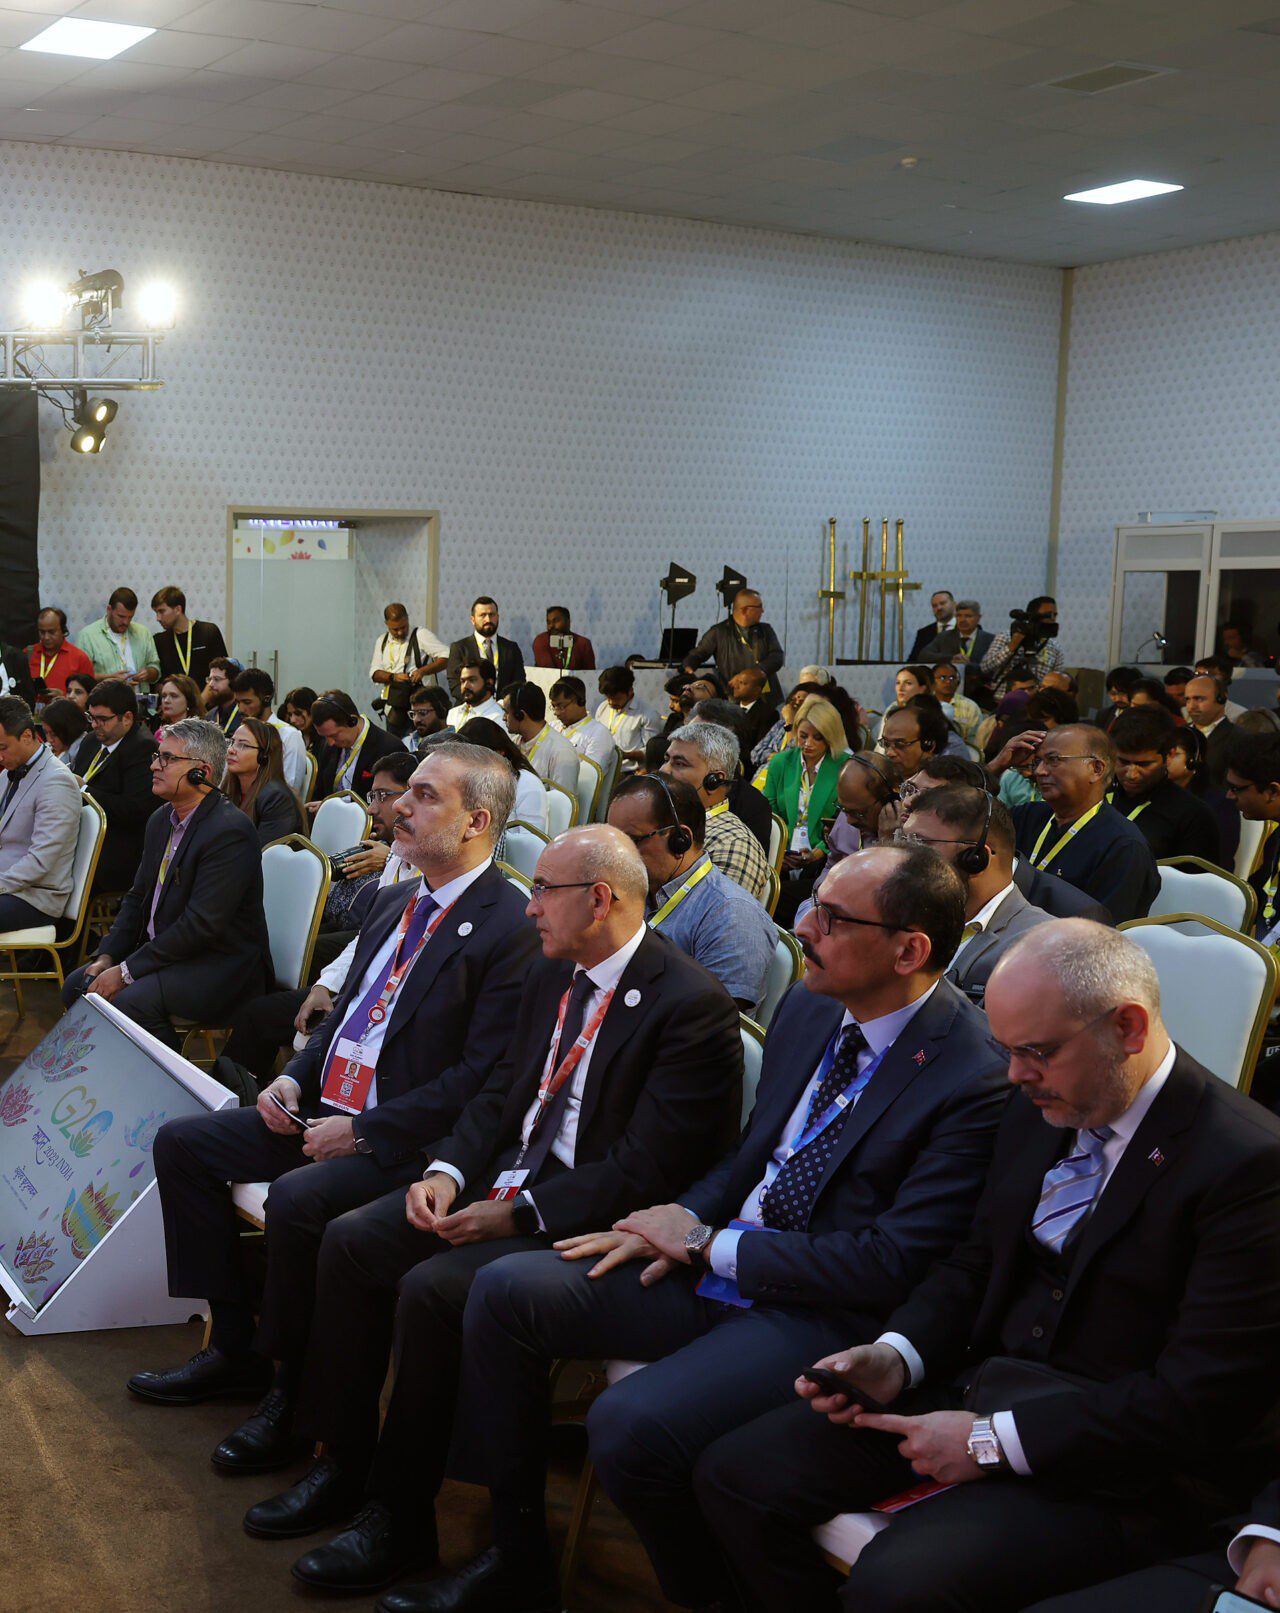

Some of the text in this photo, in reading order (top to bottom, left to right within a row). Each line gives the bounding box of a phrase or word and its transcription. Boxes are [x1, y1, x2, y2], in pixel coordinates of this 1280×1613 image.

[51, 1085, 114, 1158] G20
[43, 1145, 60, 1167] 2023
[56, 1157, 75, 1181] INDIA
